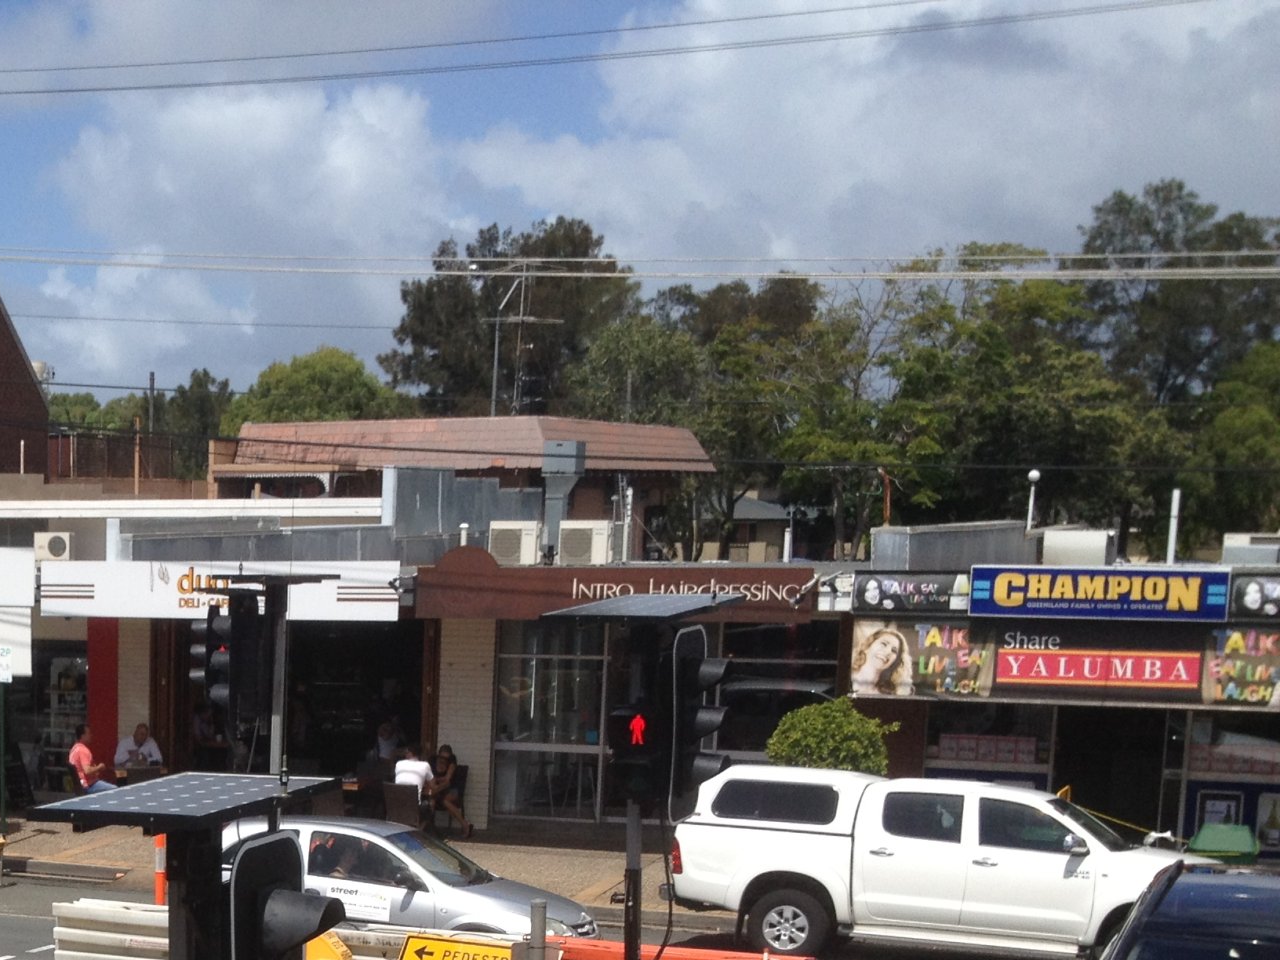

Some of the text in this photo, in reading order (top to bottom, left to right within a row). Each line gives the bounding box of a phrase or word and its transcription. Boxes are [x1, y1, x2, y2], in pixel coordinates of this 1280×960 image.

[178, 597, 230, 608] DELI CAF
[993, 572, 1201, 611] CHAMPION
[915, 624, 970, 651] TALK
[1004, 632, 1061, 650] Share
[1006, 655, 1190, 681] YALUMBA
